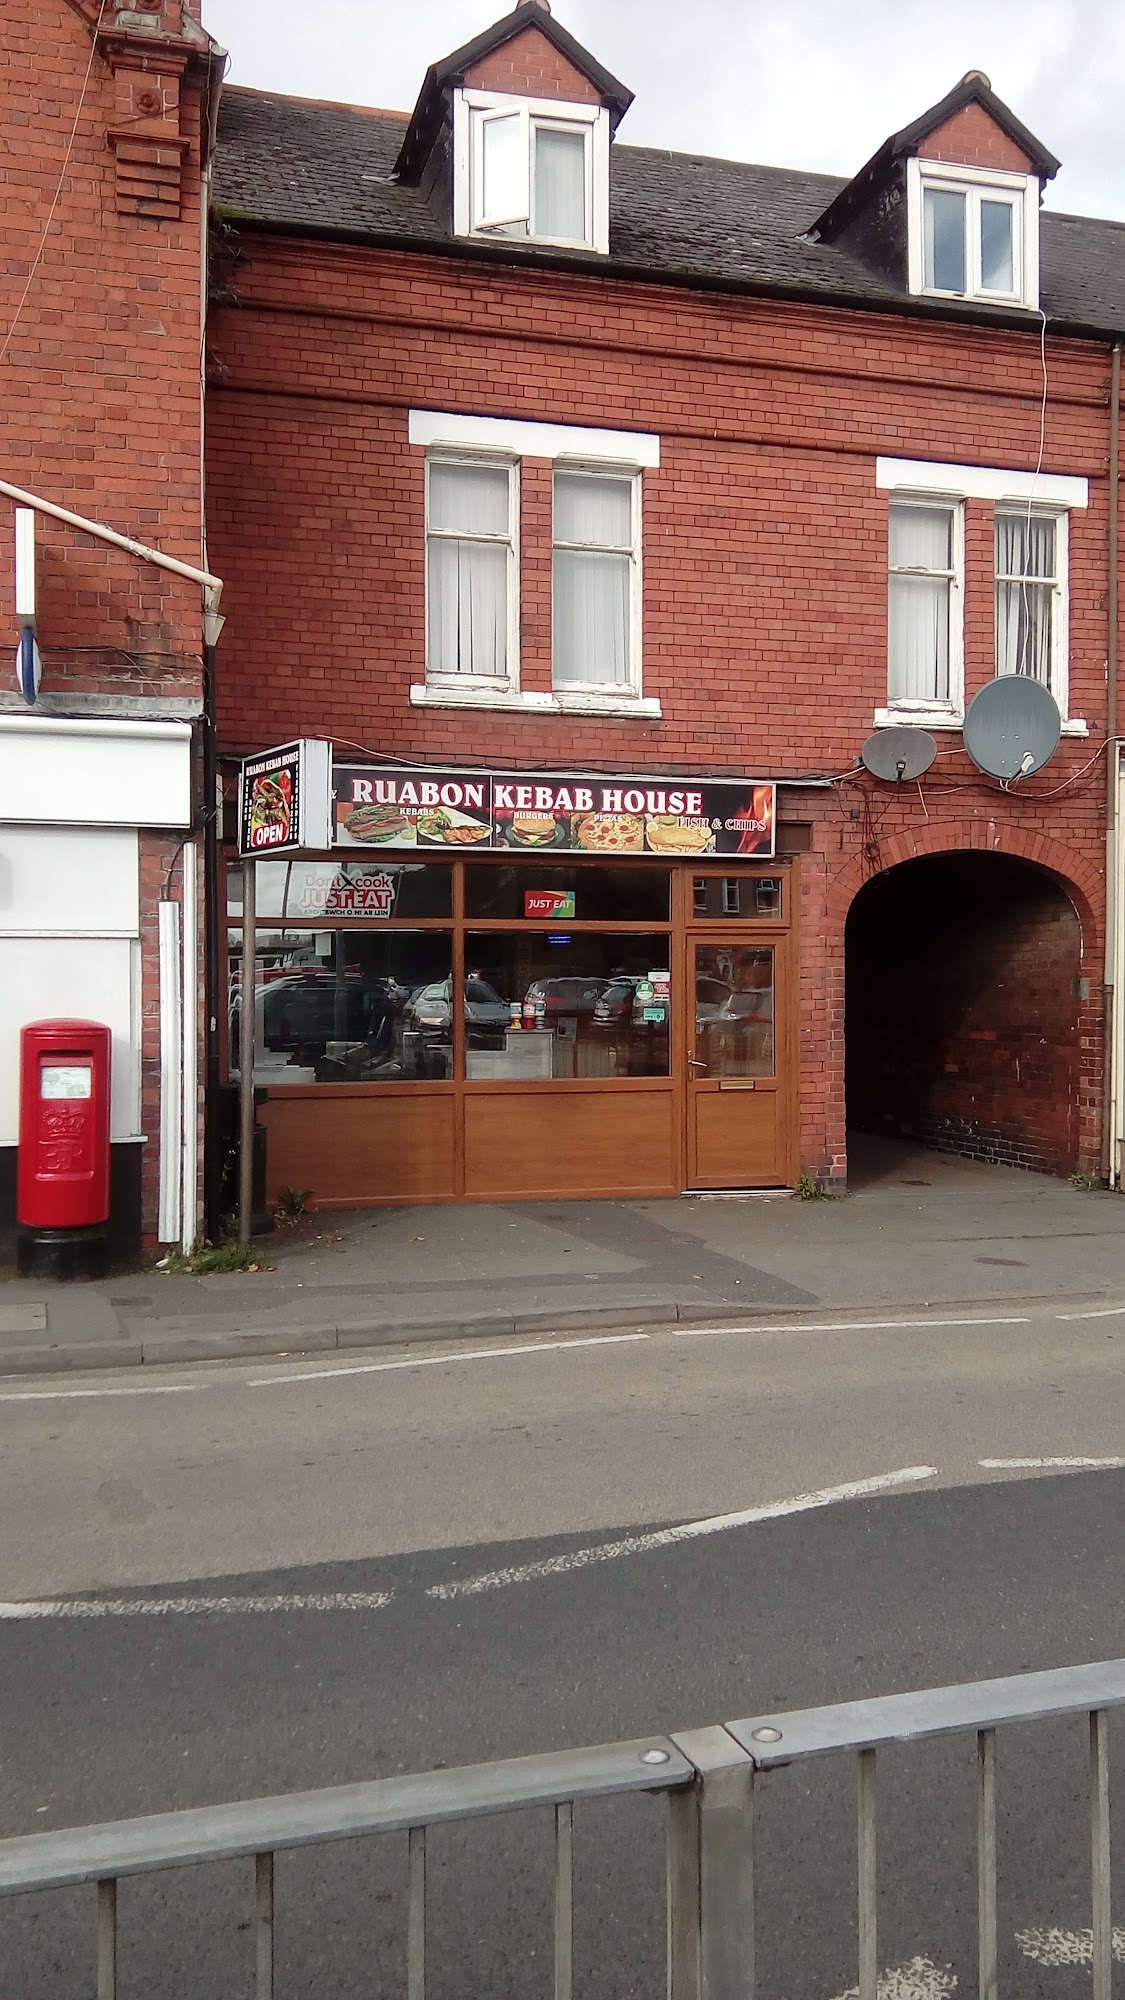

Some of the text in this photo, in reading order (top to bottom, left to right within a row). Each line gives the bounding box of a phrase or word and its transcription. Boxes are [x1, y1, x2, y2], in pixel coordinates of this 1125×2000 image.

[282, 751, 299, 766] HOUSE
[352, 779, 701, 815] RUABON KEBAB HOUSE
[399, 806, 434, 816] KEBABS
[513, 811, 554, 820] BURGERS
[593, 813, 623, 822] PIZZAS
[676, 817, 767, 831] FISH & CHIPS
[256, 823, 283, 846] OPEN
[355, 876, 390, 888] cook
[301, 889, 389, 908] JUST EAT
[528, 899, 571, 909] JUST EAT
